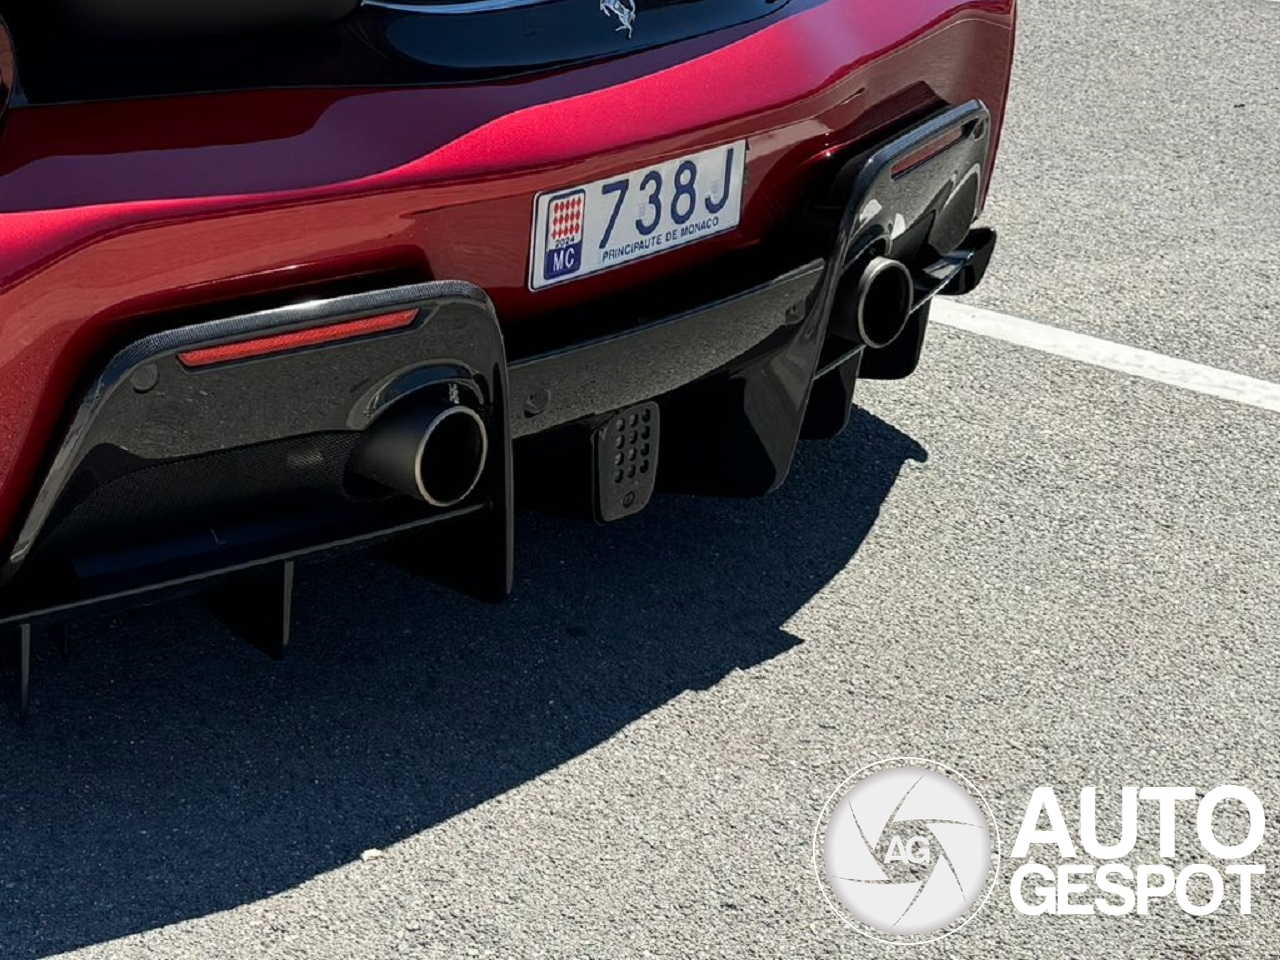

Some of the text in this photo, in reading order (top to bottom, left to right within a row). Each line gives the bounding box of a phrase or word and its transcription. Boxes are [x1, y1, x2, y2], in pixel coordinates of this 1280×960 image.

[599, 148, 734, 249] 738J
[665, 229, 677, 242] DE
[680, 216, 719, 237] MONACO
[553, 247, 575, 272] MC
